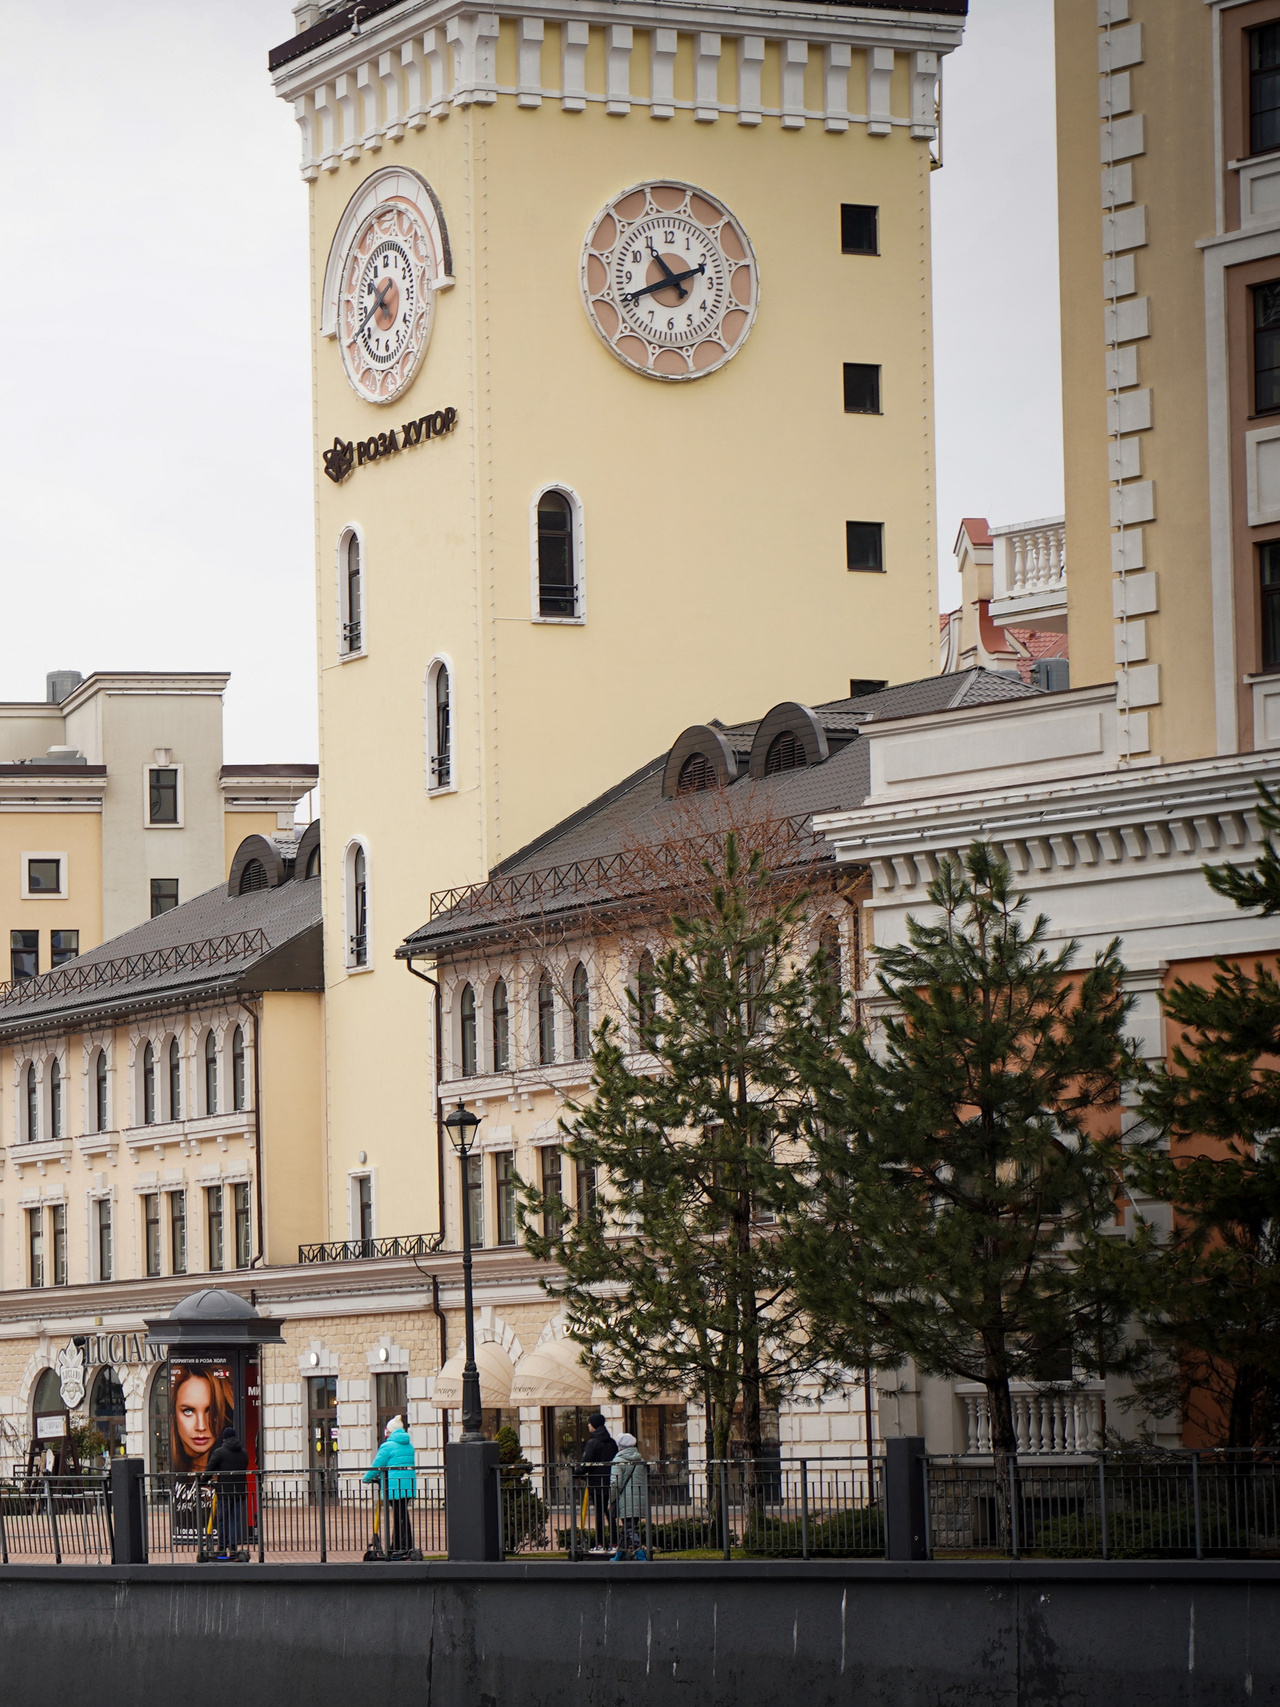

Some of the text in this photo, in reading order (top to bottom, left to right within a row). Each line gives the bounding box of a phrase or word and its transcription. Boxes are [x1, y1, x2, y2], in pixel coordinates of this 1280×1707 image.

[644, 236, 654, 249] 11
[664, 231, 675, 243] 12
[686, 238, 690, 250] 1
[631, 250, 642, 263] 10
[700, 254, 707, 267] 2
[402, 267, 406, 280] 2
[625, 271, 632, 284] 9
[707, 277, 714, 290] 3
[699, 300, 707, 312] 4
[402, 312, 409, 324] 4
[648, 311, 655, 324] 7
[667, 317, 674, 331] 6
[687, 314, 693, 327] 5
[395, 330, 400, 343] 5
[375, 337, 380, 351] 7
[385, 339, 390, 352] 6
[356, 406, 457, 466] РОЗА ХУТОР
